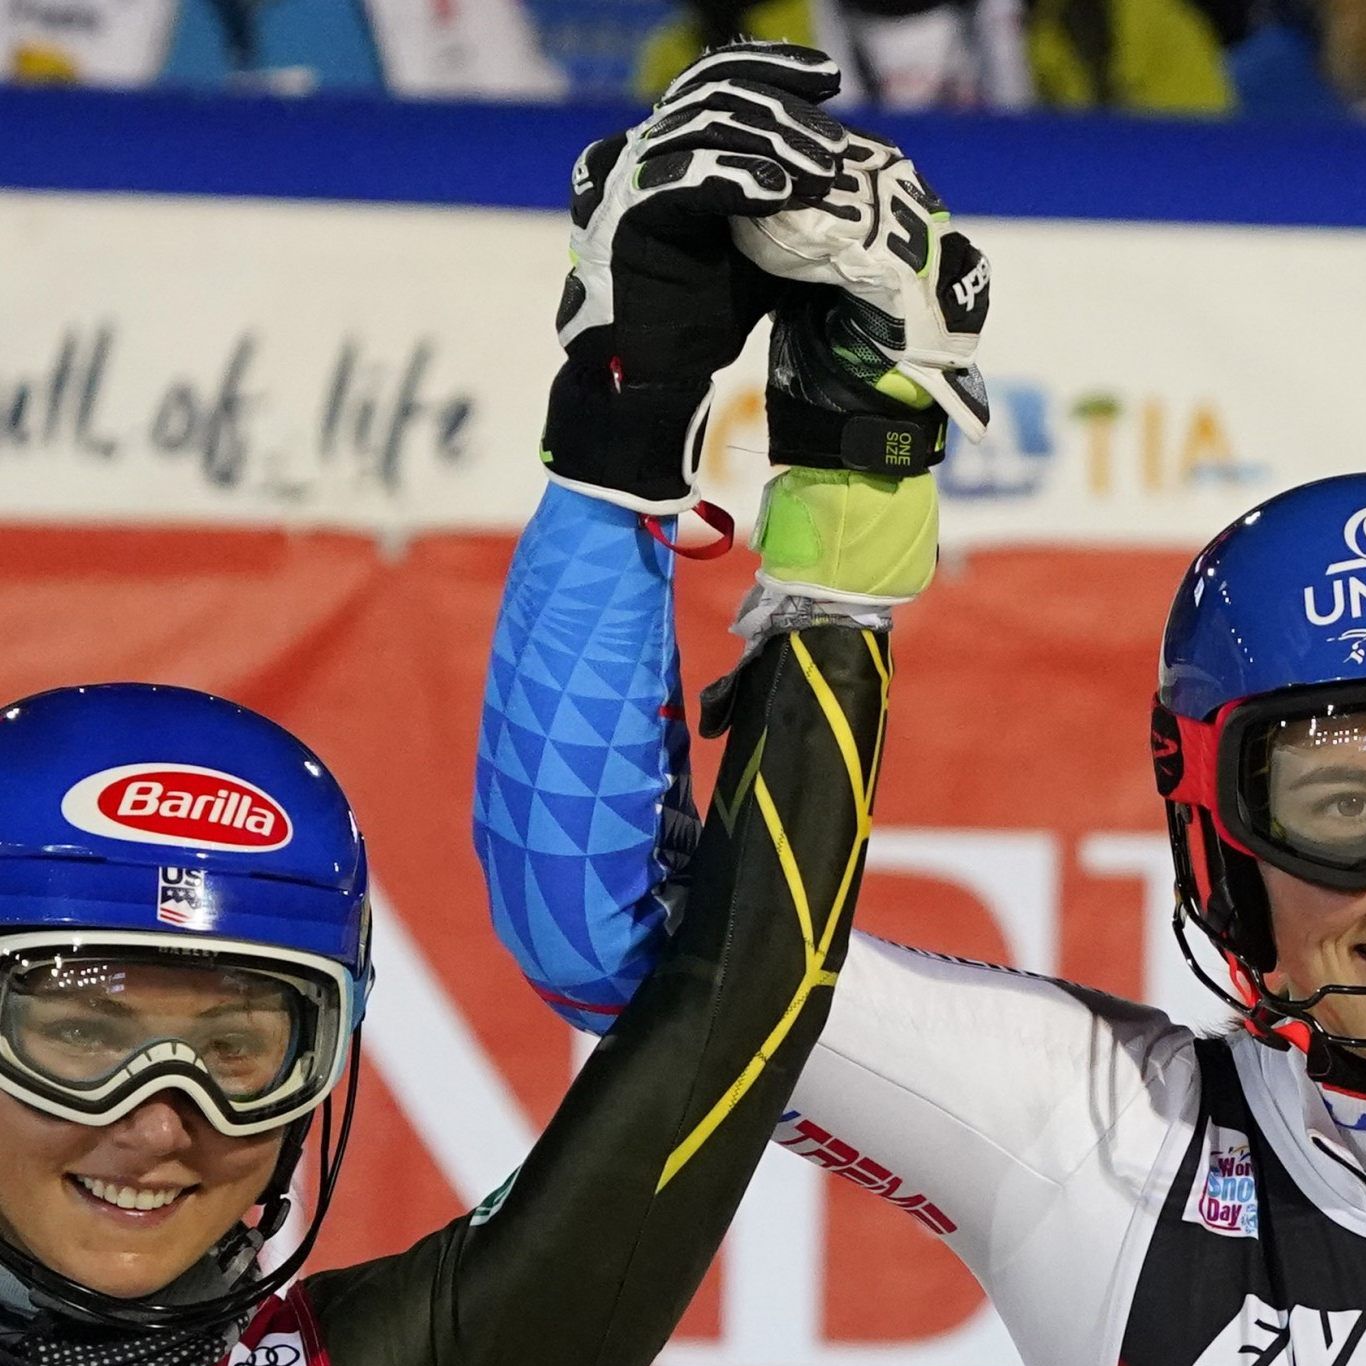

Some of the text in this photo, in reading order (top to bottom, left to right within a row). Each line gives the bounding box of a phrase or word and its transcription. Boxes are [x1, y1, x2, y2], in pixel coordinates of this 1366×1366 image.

[150, 330, 262, 490] of
[318, 332, 476, 495] life
[885, 431, 899, 465] SIZE
[899, 432, 912, 466] ONE
[117, 781, 276, 837] Barilla
[1207, 1198, 1243, 1227] Day
